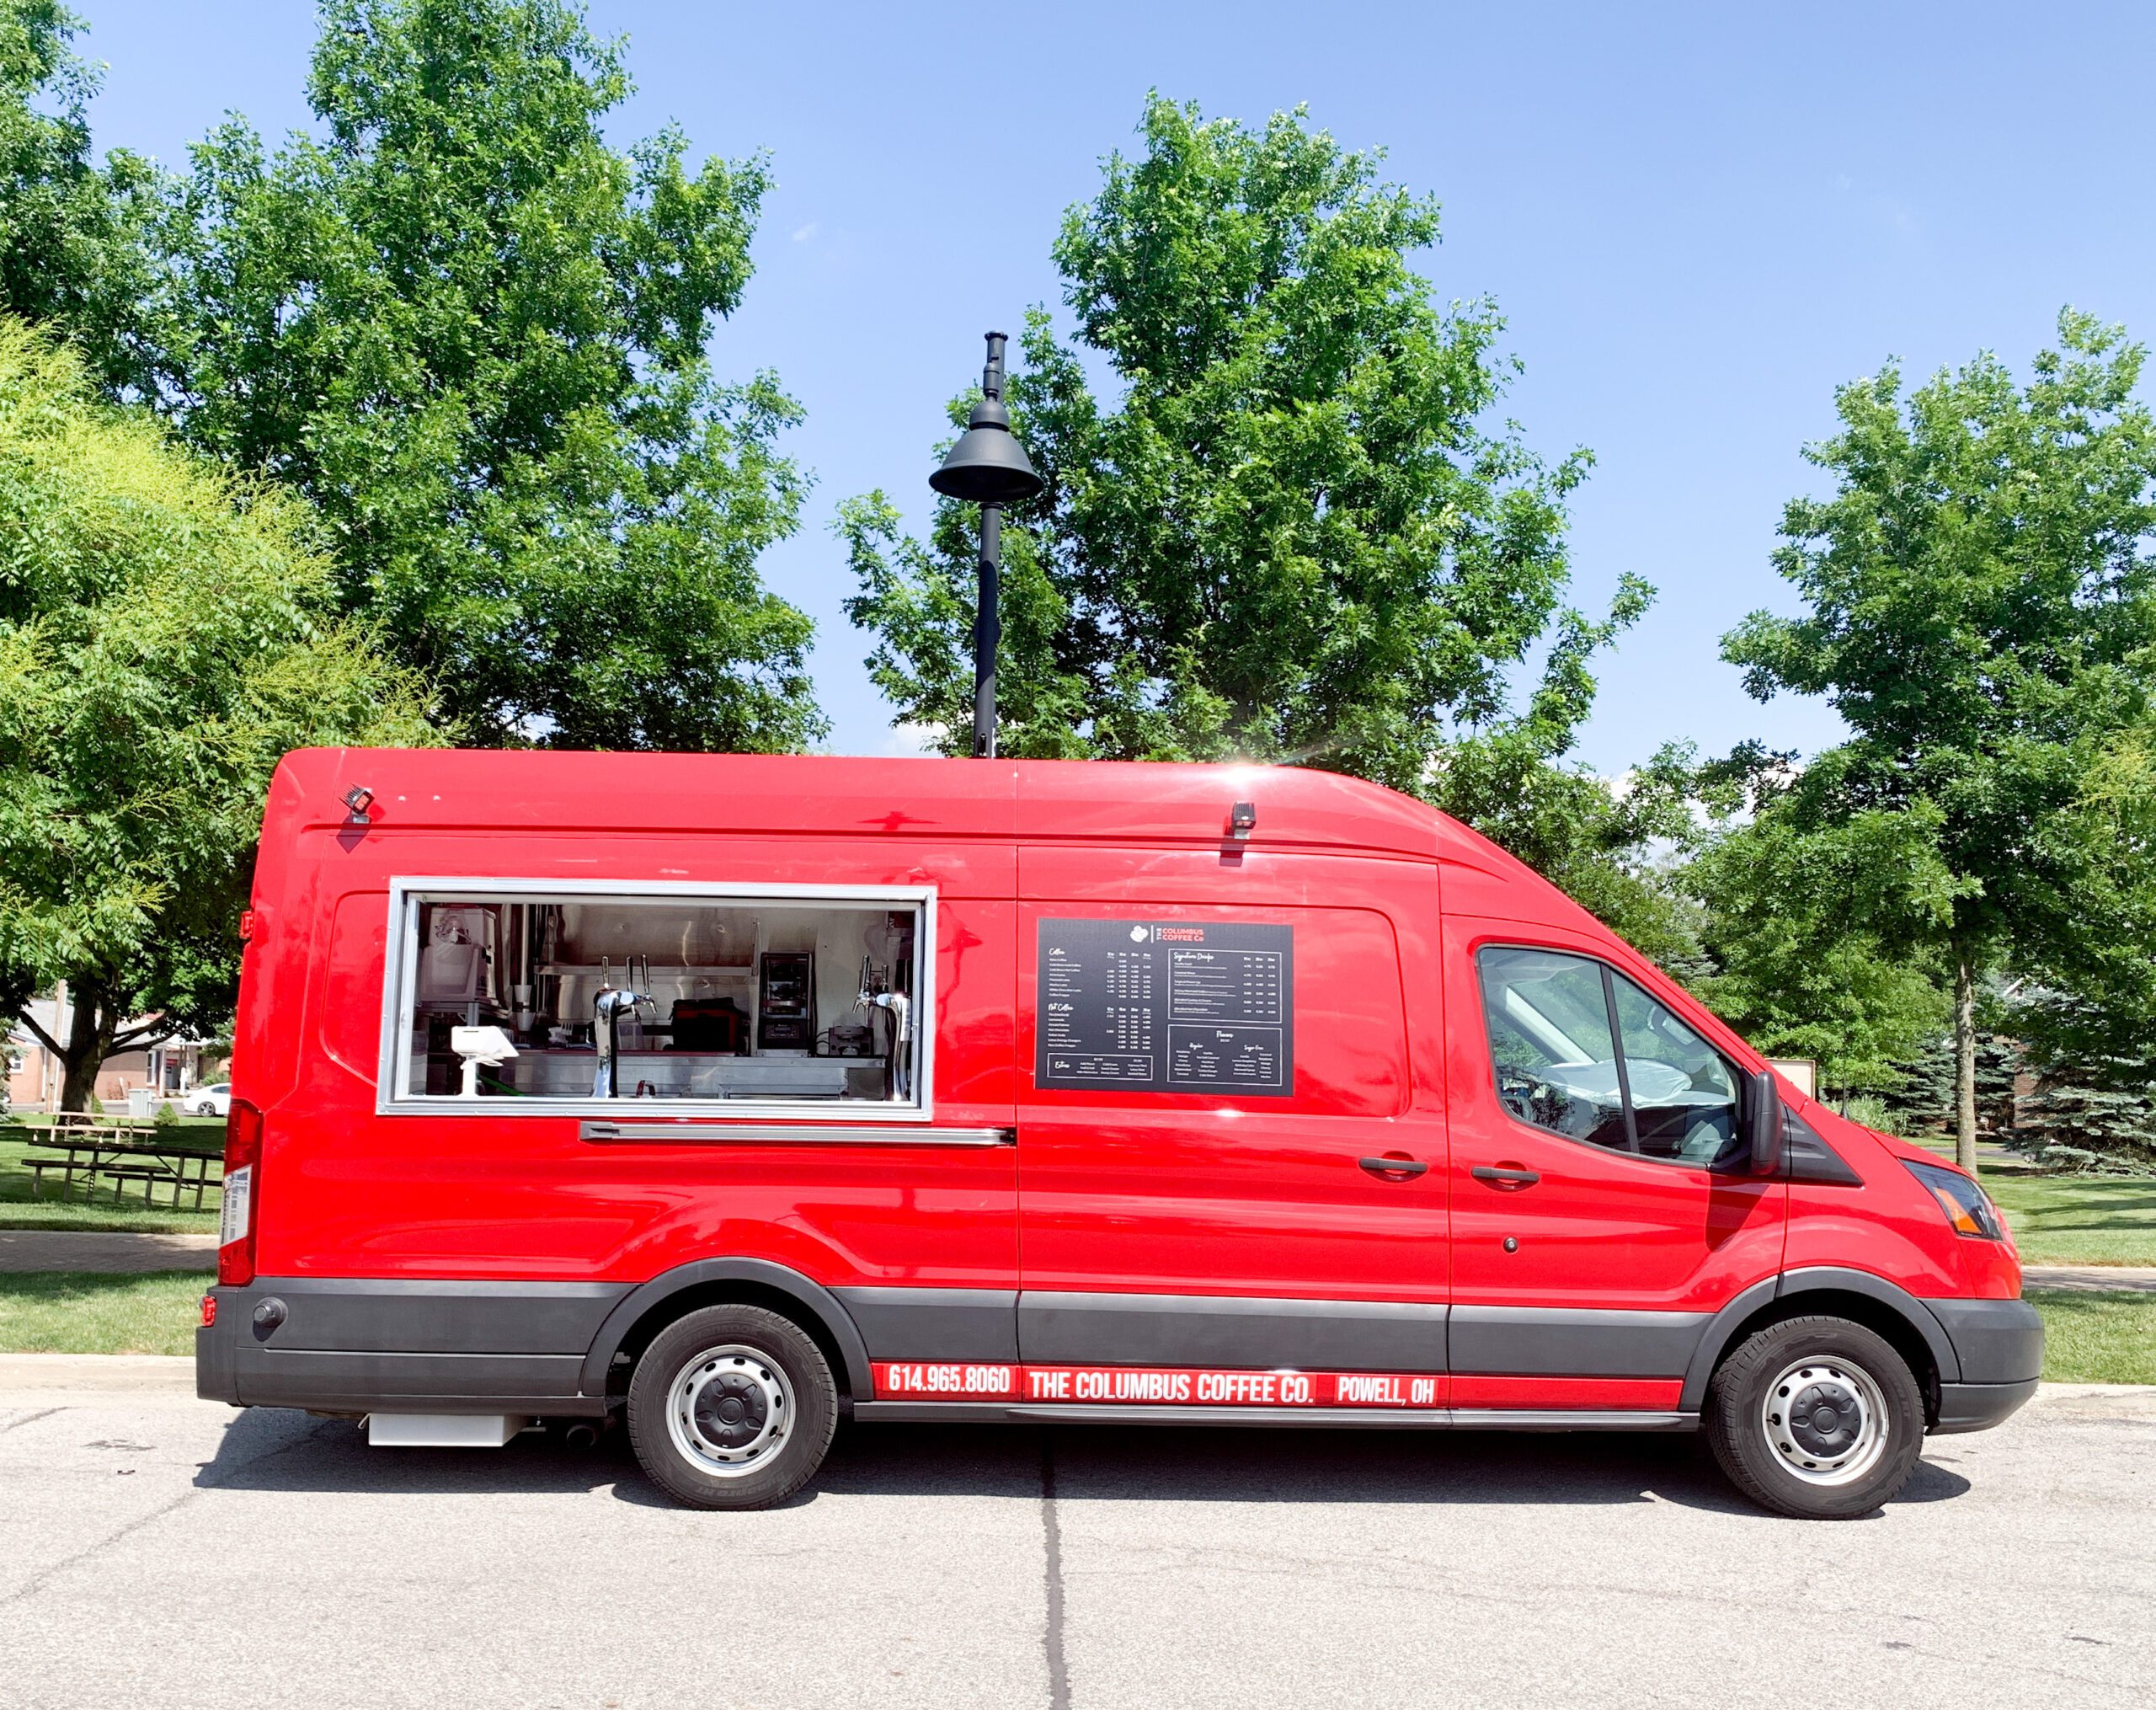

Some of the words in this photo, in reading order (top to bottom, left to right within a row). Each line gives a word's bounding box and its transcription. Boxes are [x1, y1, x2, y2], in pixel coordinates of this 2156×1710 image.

[1174, 951, 1197, 962] Signature
[889, 1365, 1011, 1393] 614.965.8060
[1029, 1371, 1070, 1398] THE
[1075, 1372, 1191, 1400] COLUMBUS
[1197, 1374, 1276, 1402] COFFEE
[1280, 1376, 1314, 1403] CO.
[1337, 1377, 1406, 1406] POWELL,
[1412, 1379, 1435, 1404] OH
